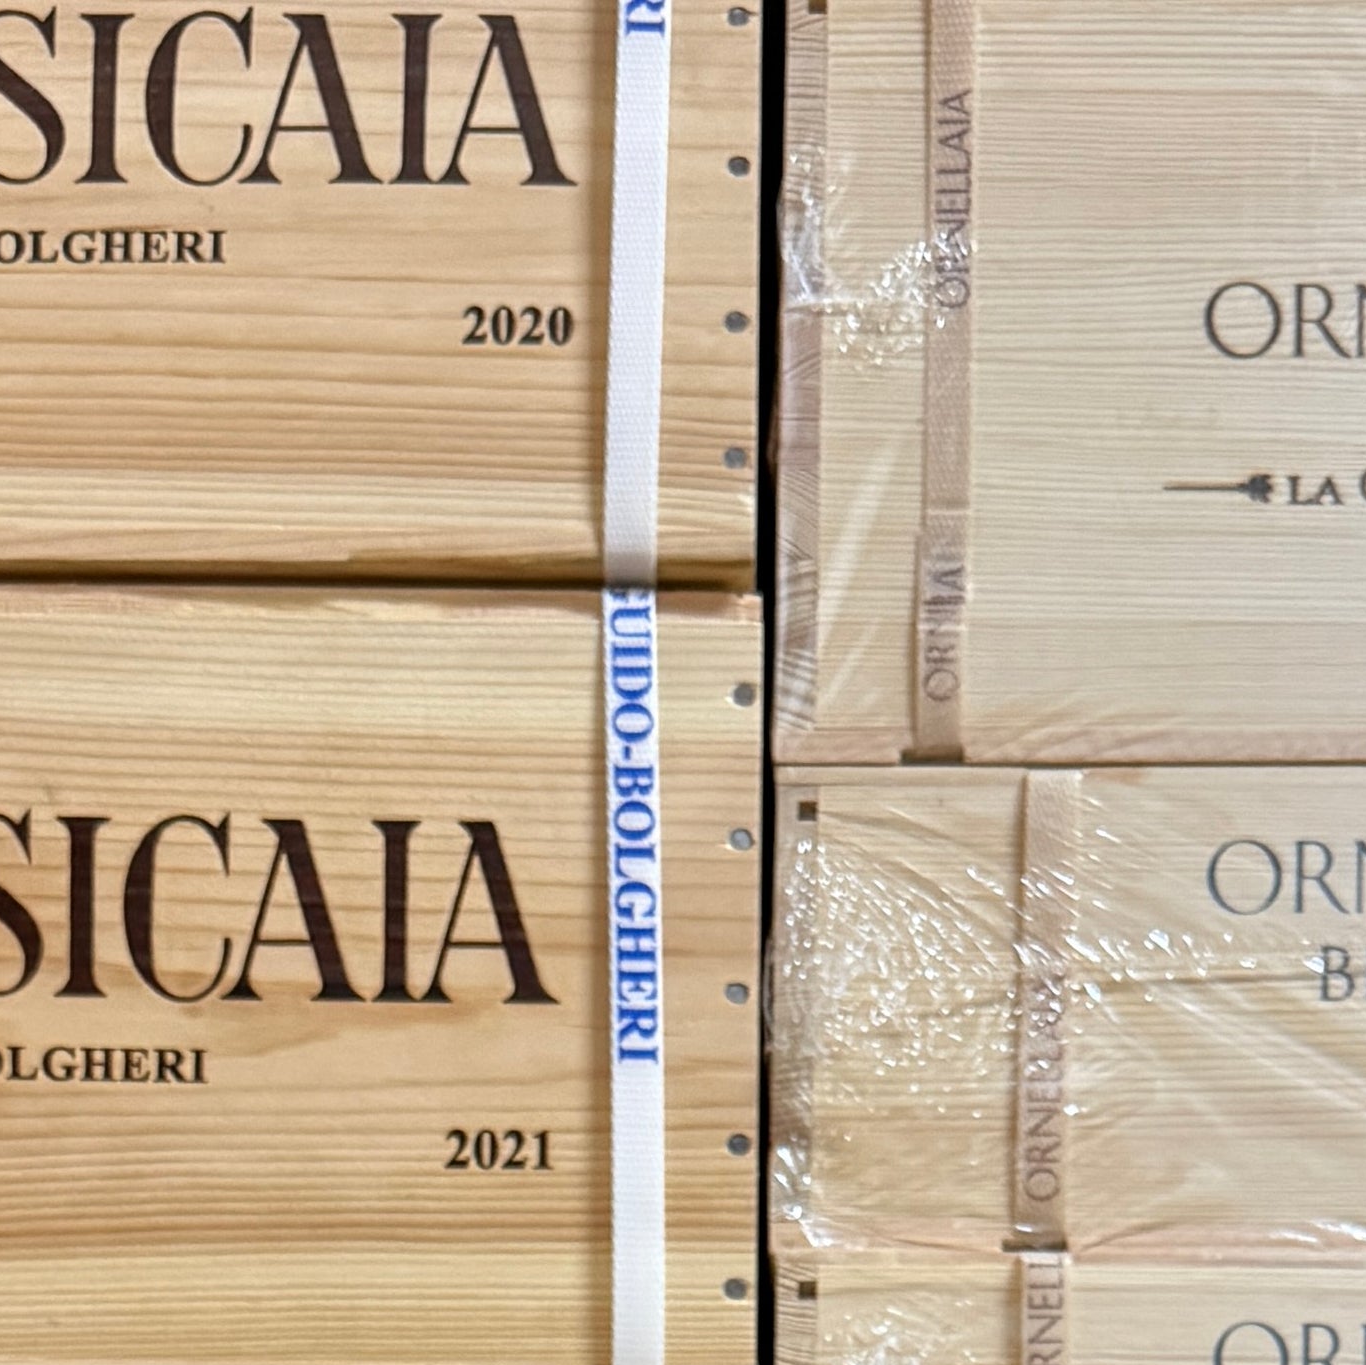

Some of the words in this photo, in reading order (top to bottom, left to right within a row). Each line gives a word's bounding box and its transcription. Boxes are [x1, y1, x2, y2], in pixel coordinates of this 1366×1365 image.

[462, 305, 574, 346] 2020
[608, 588, 661, 1065] UIDO-BOLGHERI
[443, 1127, 555, 1172] 2021
